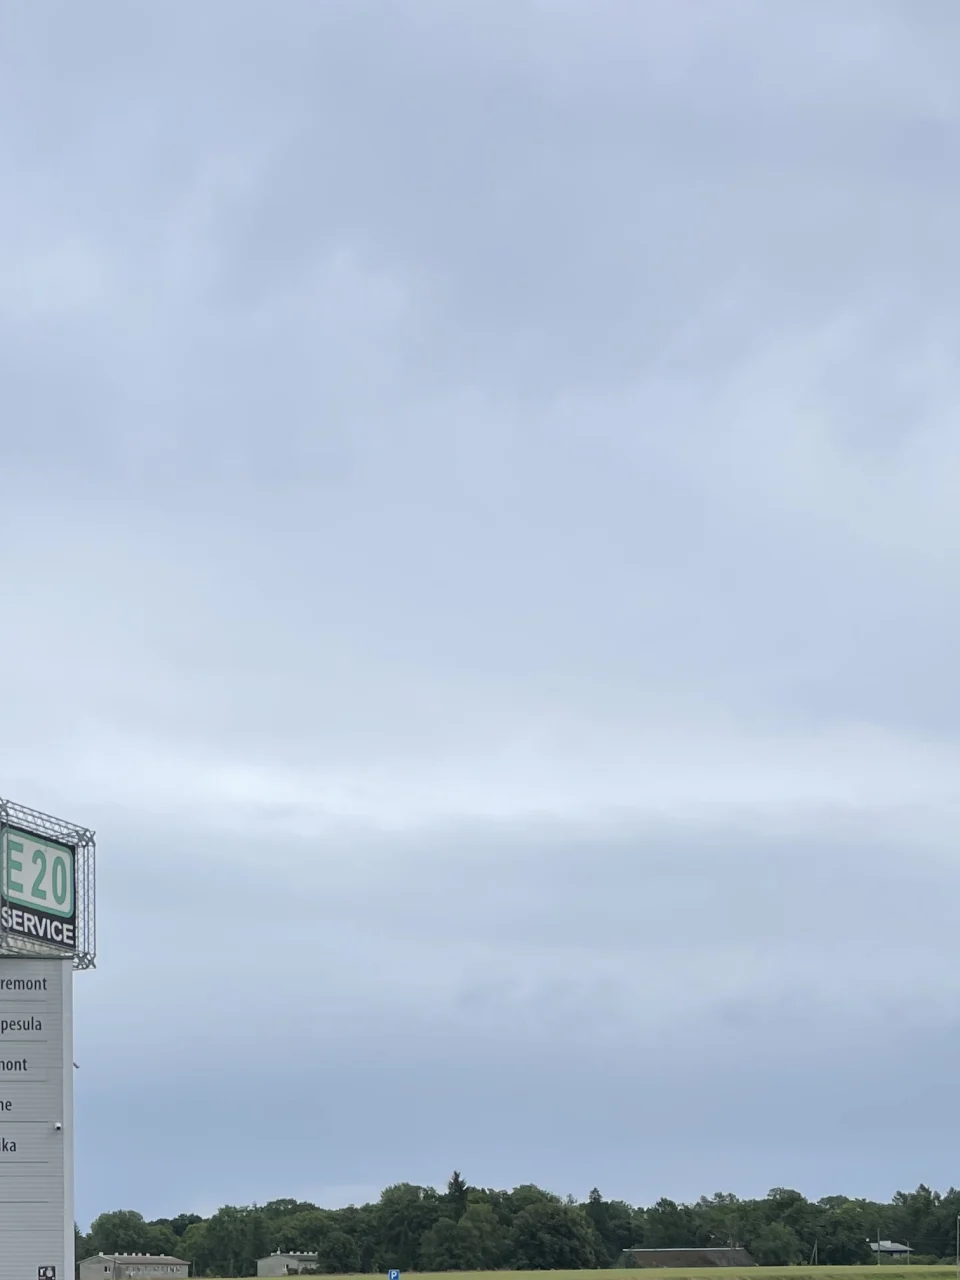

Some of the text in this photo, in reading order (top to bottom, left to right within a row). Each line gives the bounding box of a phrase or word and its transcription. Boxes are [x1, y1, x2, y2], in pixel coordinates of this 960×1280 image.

[7, 839, 67, 905] E 20
[1, 906, 74, 945] SERVICE
[0, 977, 48, 991] remont
[1, 1016, 42, 1034] pesula
